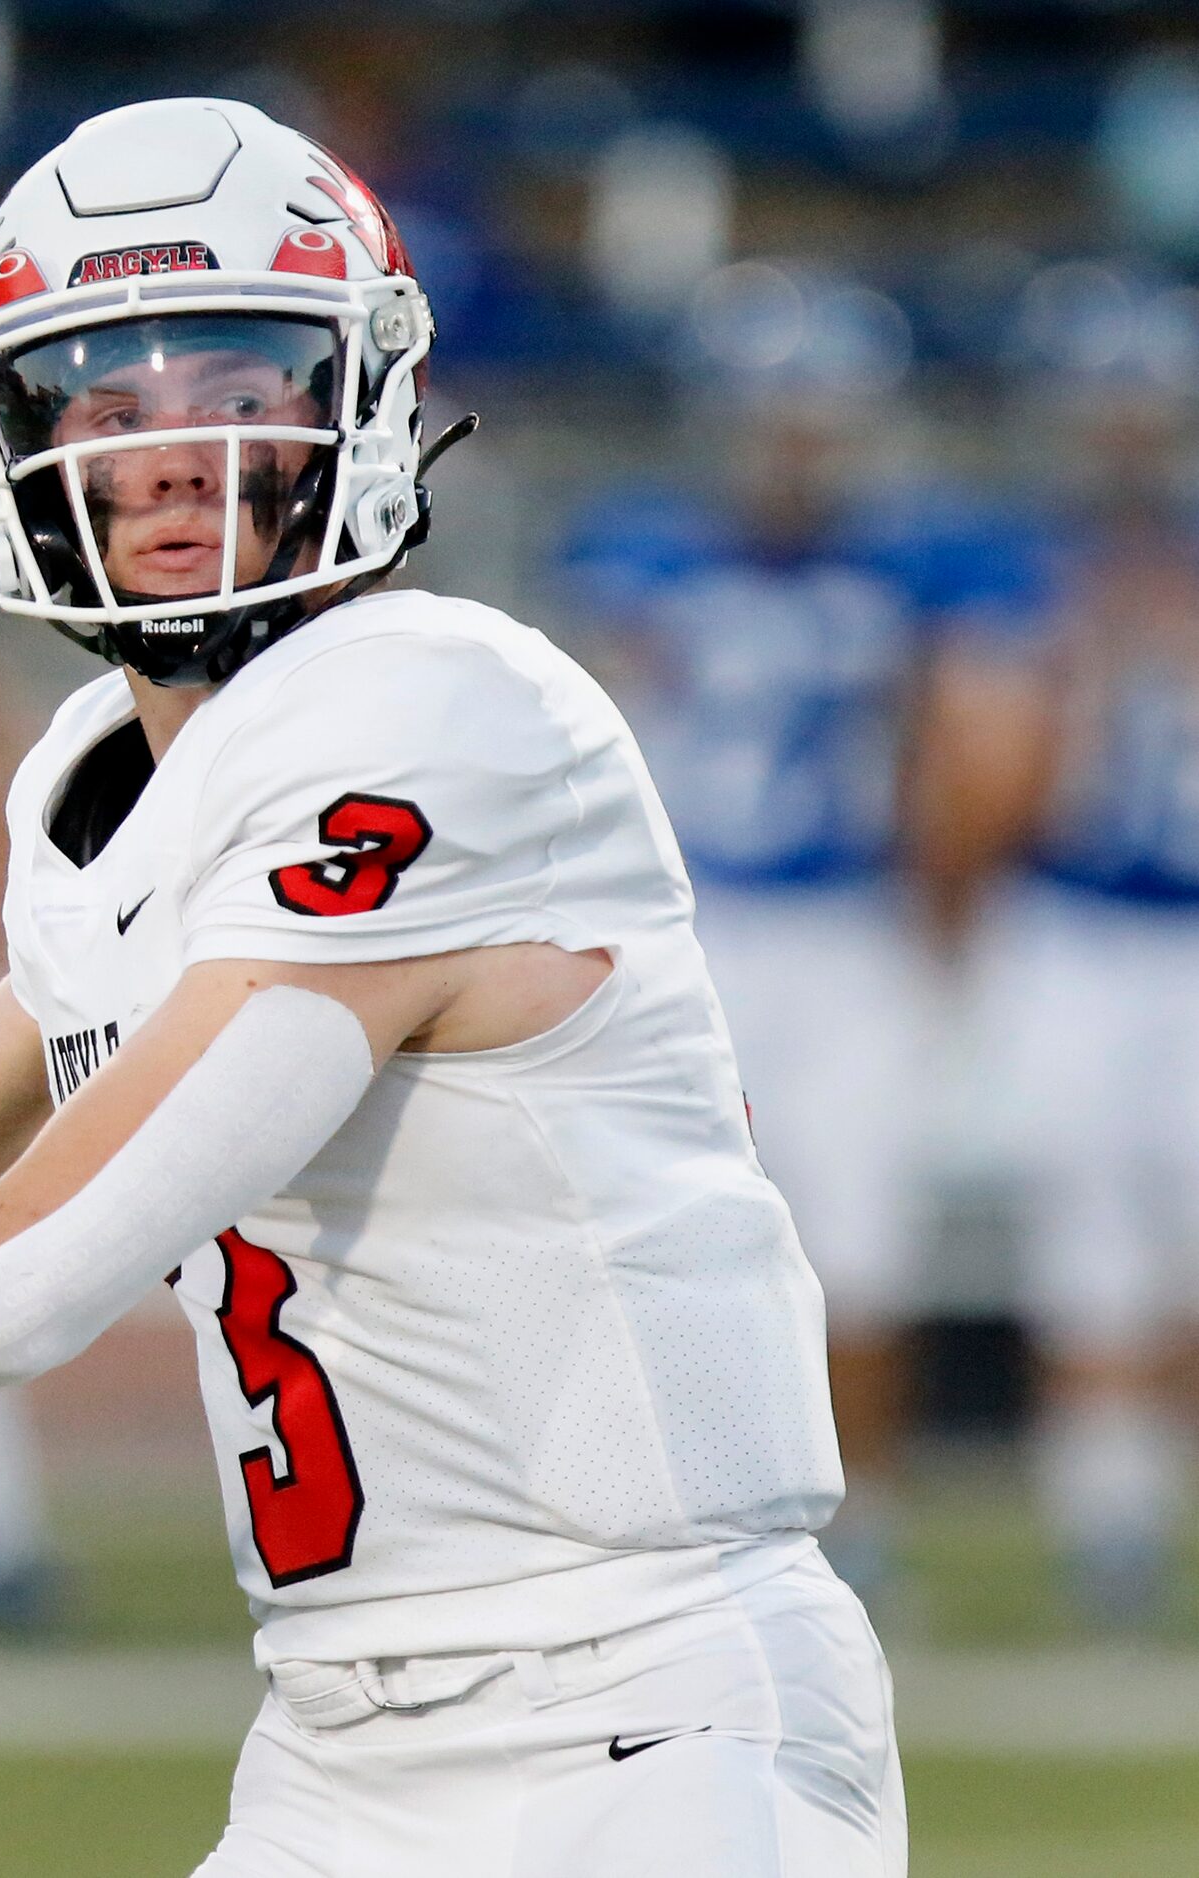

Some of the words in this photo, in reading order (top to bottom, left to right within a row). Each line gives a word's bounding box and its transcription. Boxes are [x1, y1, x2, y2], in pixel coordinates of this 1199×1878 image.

[79, 245, 208, 286] ARGYLE
[141, 618, 205, 634] Riddell
[268, 791, 434, 917] 3
[164, 1224, 365, 1590] 3
